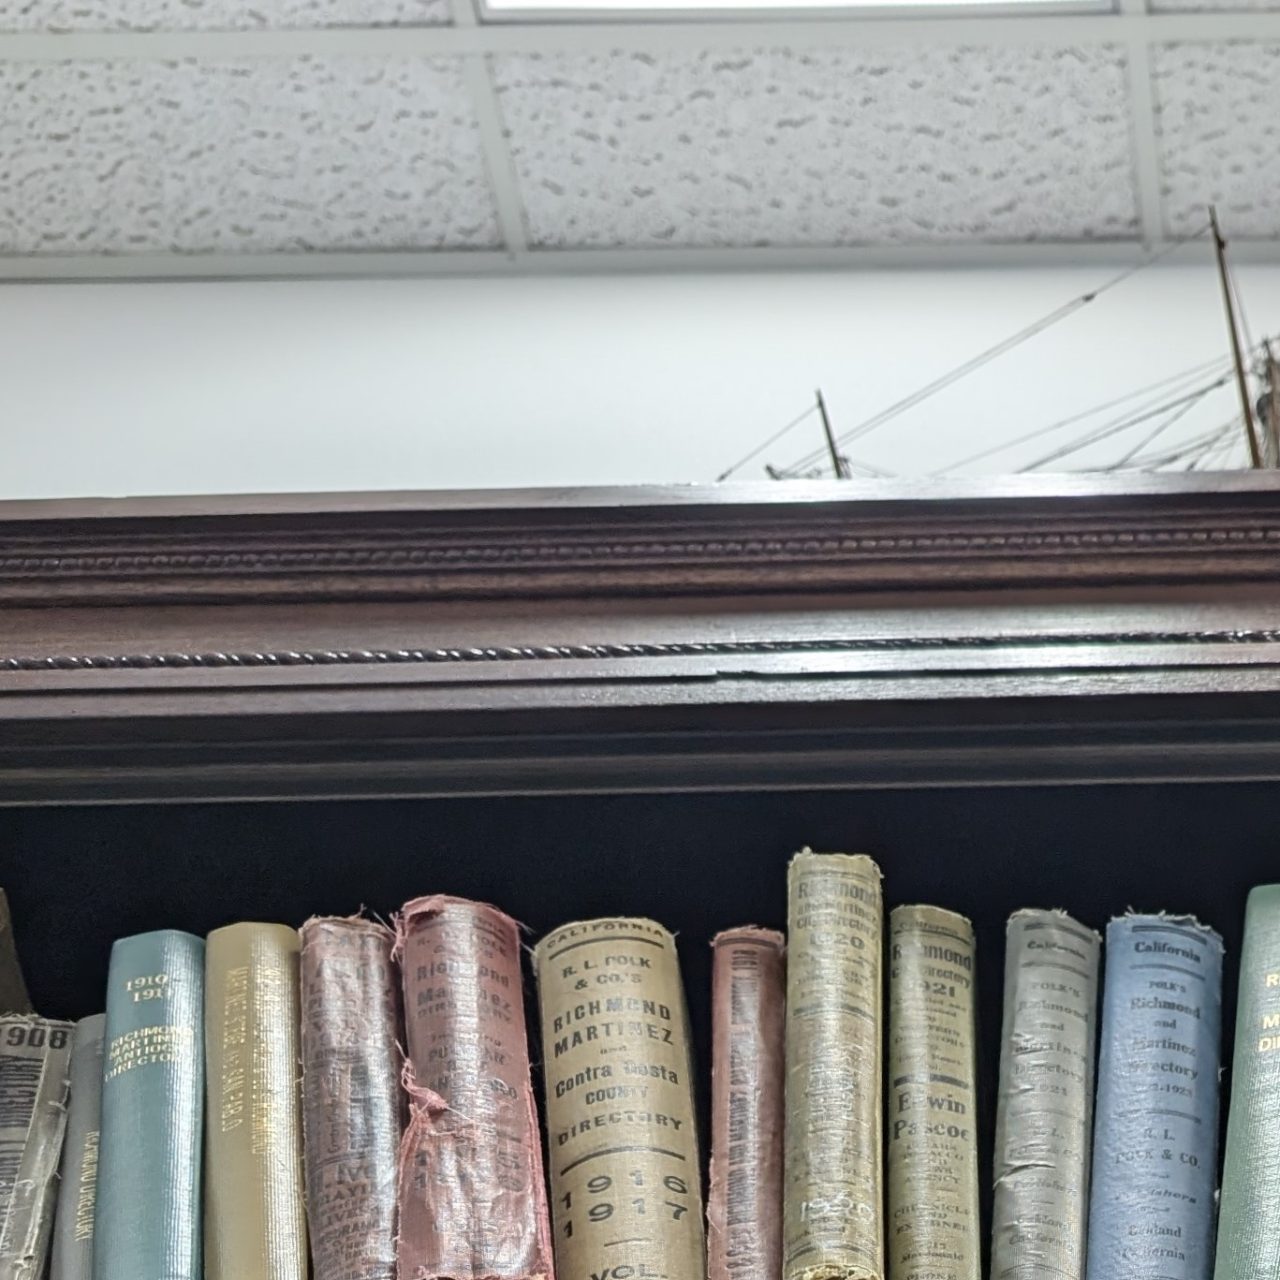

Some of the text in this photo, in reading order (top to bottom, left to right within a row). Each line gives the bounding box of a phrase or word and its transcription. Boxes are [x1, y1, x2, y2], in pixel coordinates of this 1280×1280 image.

[546, 921, 664, 949] CALIFORNIA
[1027, 940, 1086, 961] California
[1134, 942, 1201, 963] California
[561, 954, 652, 978] R. L. POLK
[124, 973, 169, 991] 1910
[574, 978, 589, 991] &
[553, 998, 671, 1034] RICHMOND
[1131, 998, 1201, 1019] Richmond
[0, 1027, 68, 1049] 908
[553, 1021, 674, 1059] MARTINEZ
[555, 1062, 679, 1099] Contra Costa
[585, 1085, 649, 1106] COUNTY
[898, 1090, 966, 1115] Edwin
[557, 1110, 683, 1147] DIRECTORY
[893, 1120, 970, 1140] Pascoe
[560, 1174, 689, 1212] 1916
[560, 1197, 689, 1240] 1917
